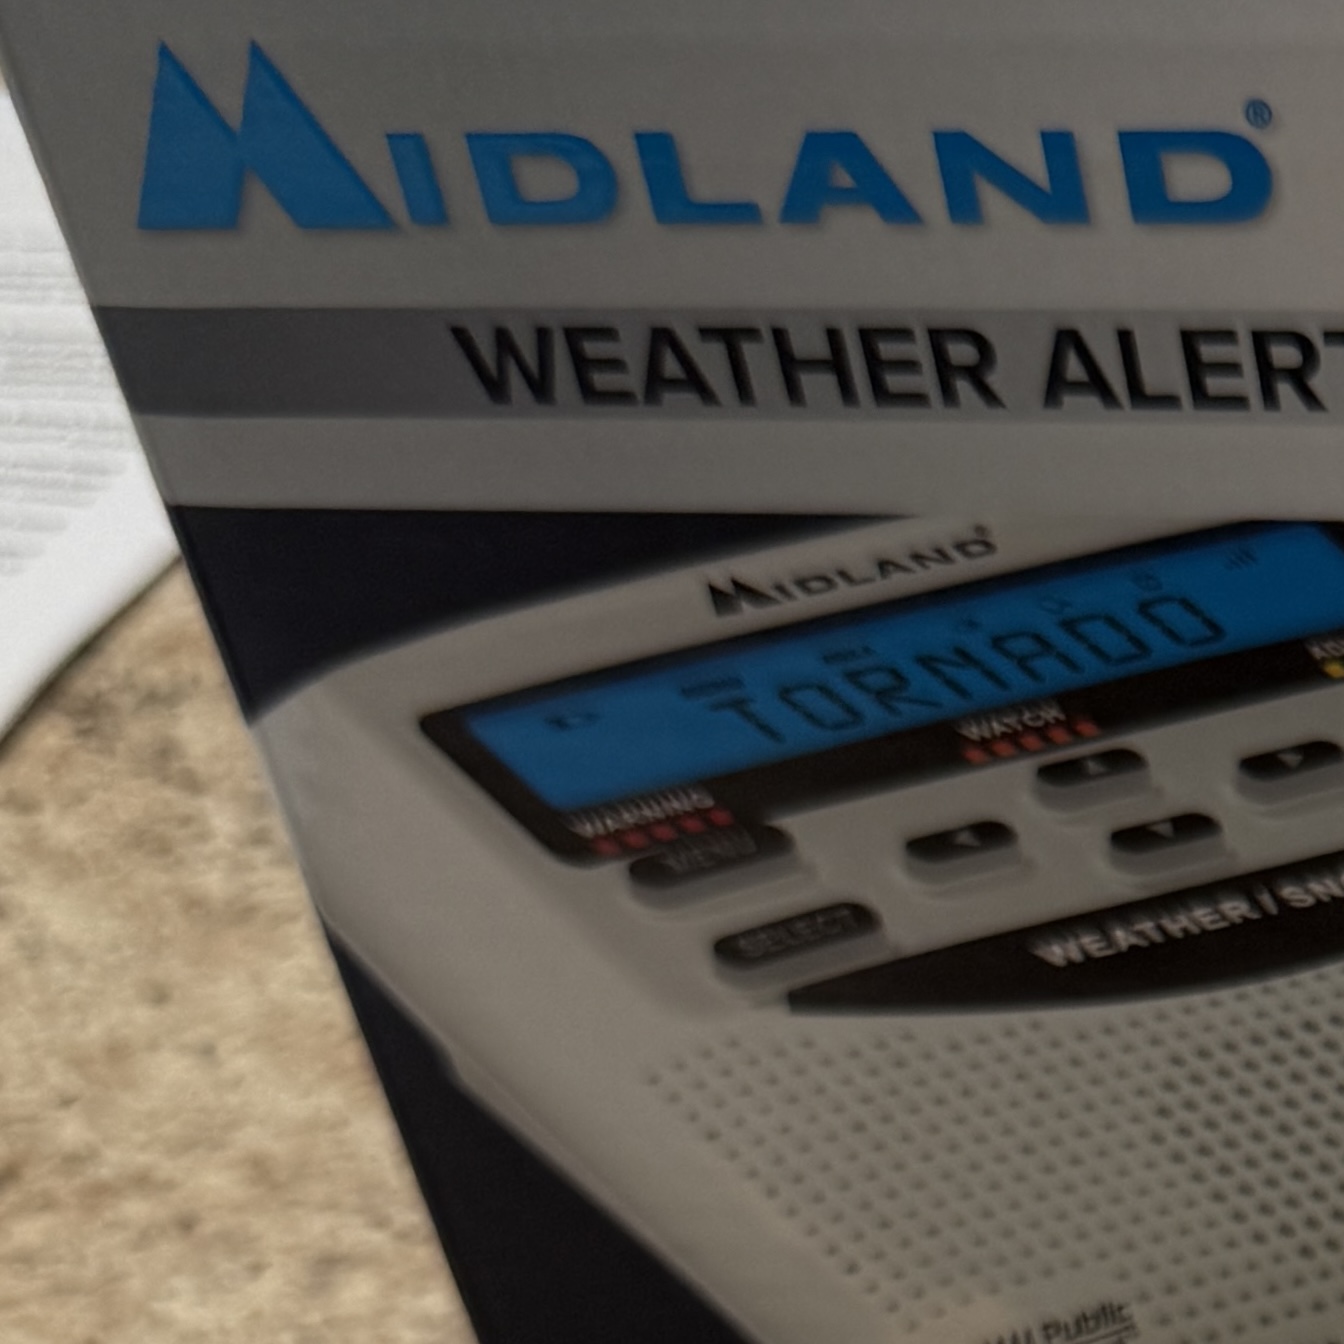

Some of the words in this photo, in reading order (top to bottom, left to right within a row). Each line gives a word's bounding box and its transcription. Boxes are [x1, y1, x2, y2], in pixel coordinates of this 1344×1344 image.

[450, 326, 1007, 409] WEATHER
[711, 598, 1227, 746] TORNADO
[955, 702, 1066, 742] WATCH
[1029, 890, 1257, 968] WEATHER
